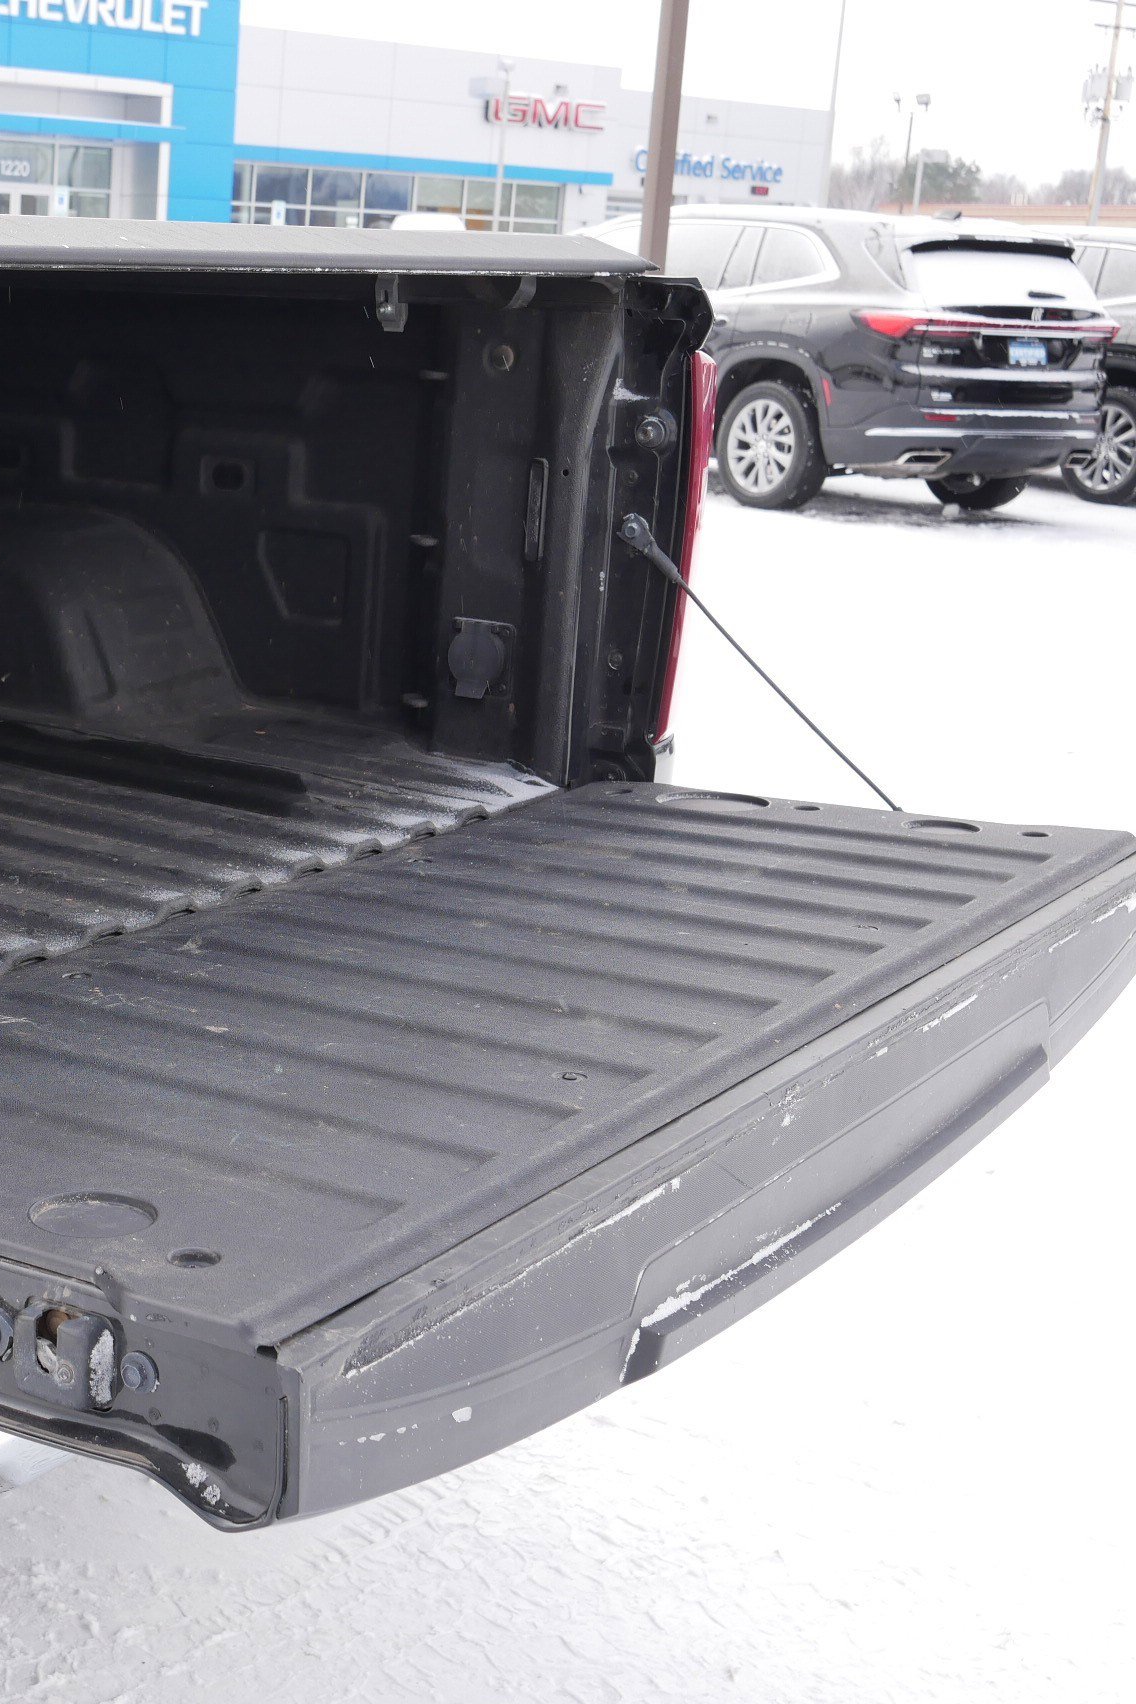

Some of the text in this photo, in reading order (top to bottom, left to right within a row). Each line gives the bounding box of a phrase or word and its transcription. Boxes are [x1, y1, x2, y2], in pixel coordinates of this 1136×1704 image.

[487, 95, 606, 131] GMC
[0, 160, 31, 177] 1220
[635, 149, 783, 183] Cified Service
